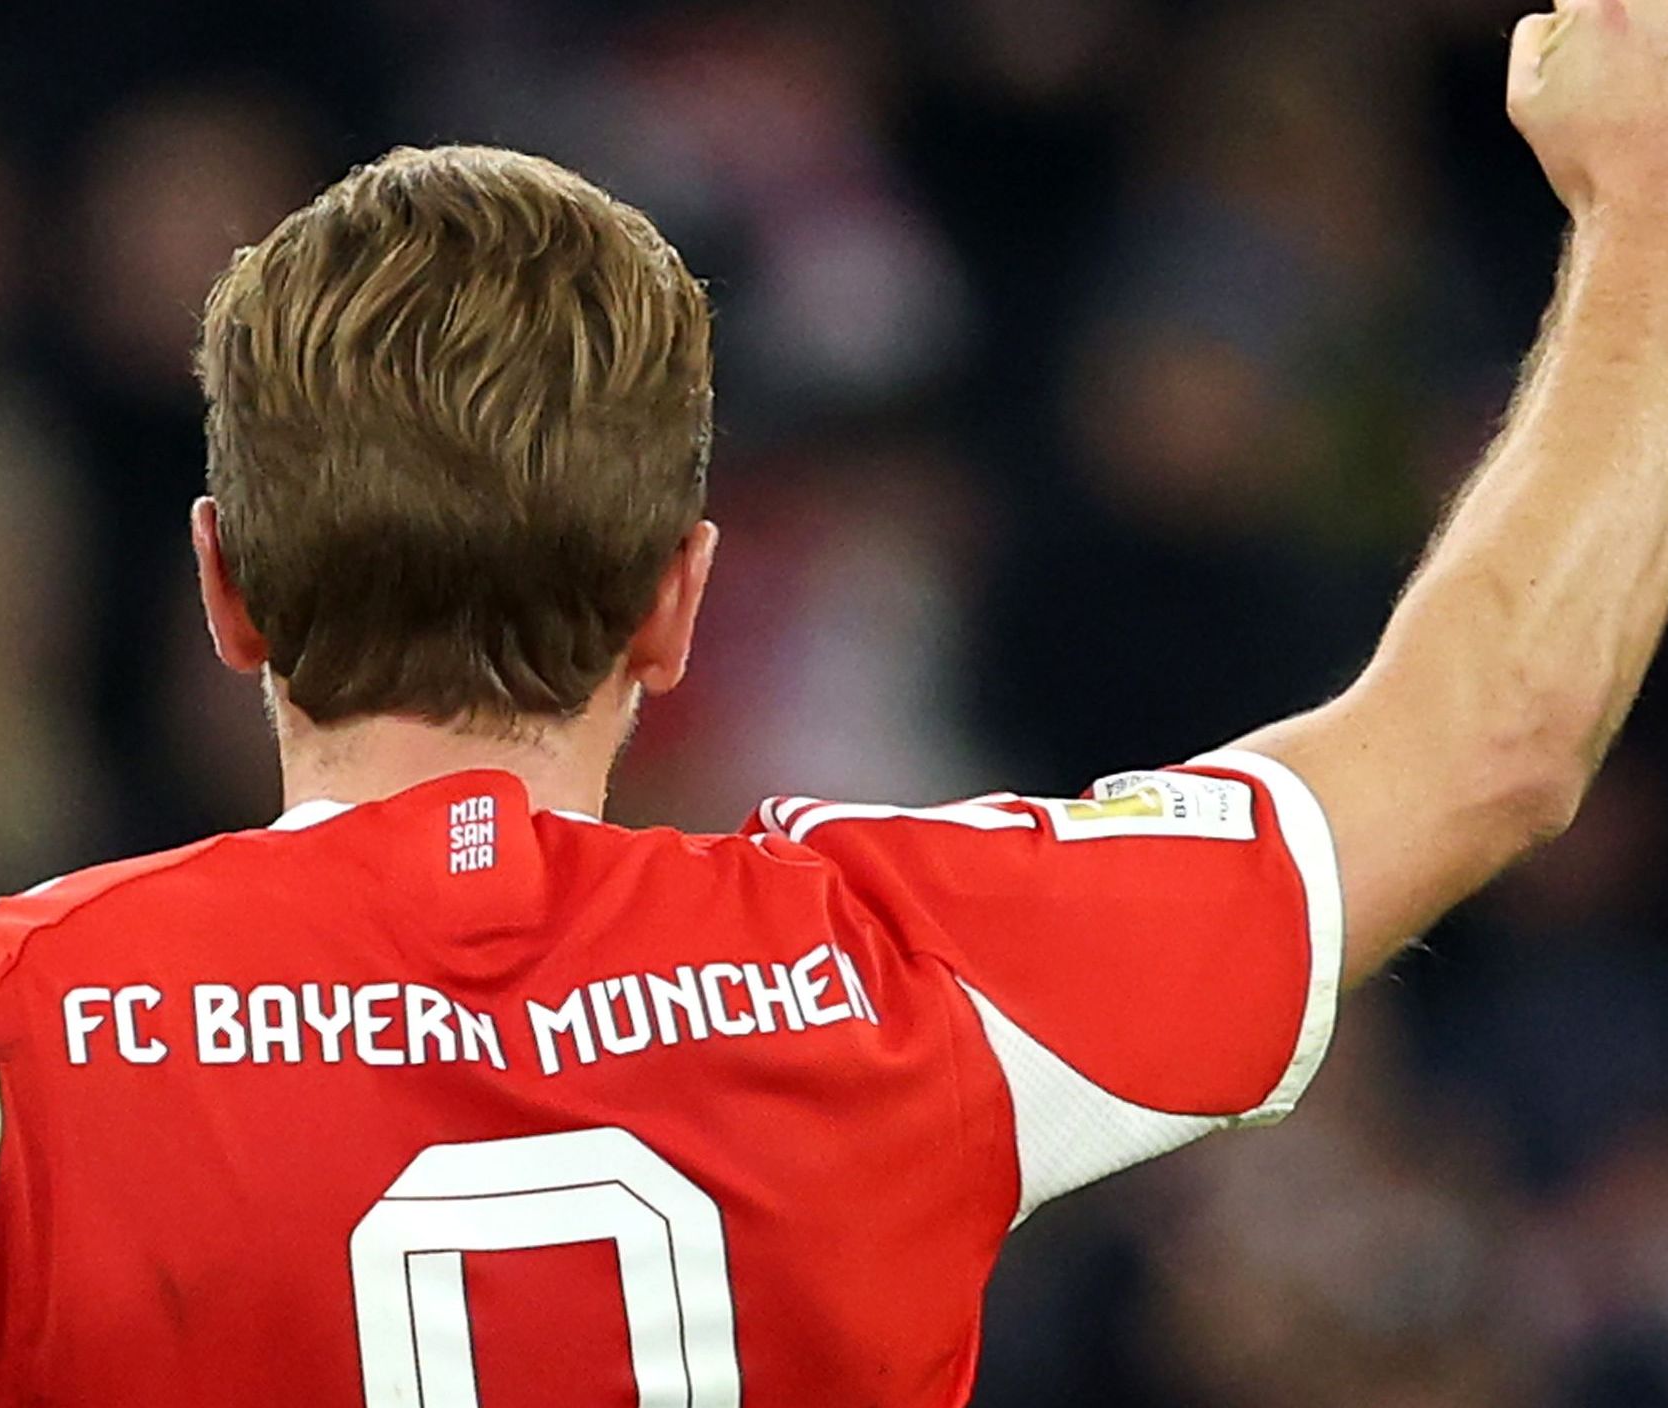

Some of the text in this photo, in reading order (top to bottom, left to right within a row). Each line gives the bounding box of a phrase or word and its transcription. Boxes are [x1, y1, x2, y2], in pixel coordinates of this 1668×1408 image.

[449, 795, 495, 825] MIA
[449, 820, 495, 850] SAN
[449, 844, 494, 874] MIA
[62, 984, 168, 1065] FC
[193, 982, 507, 1070] BAYERN
